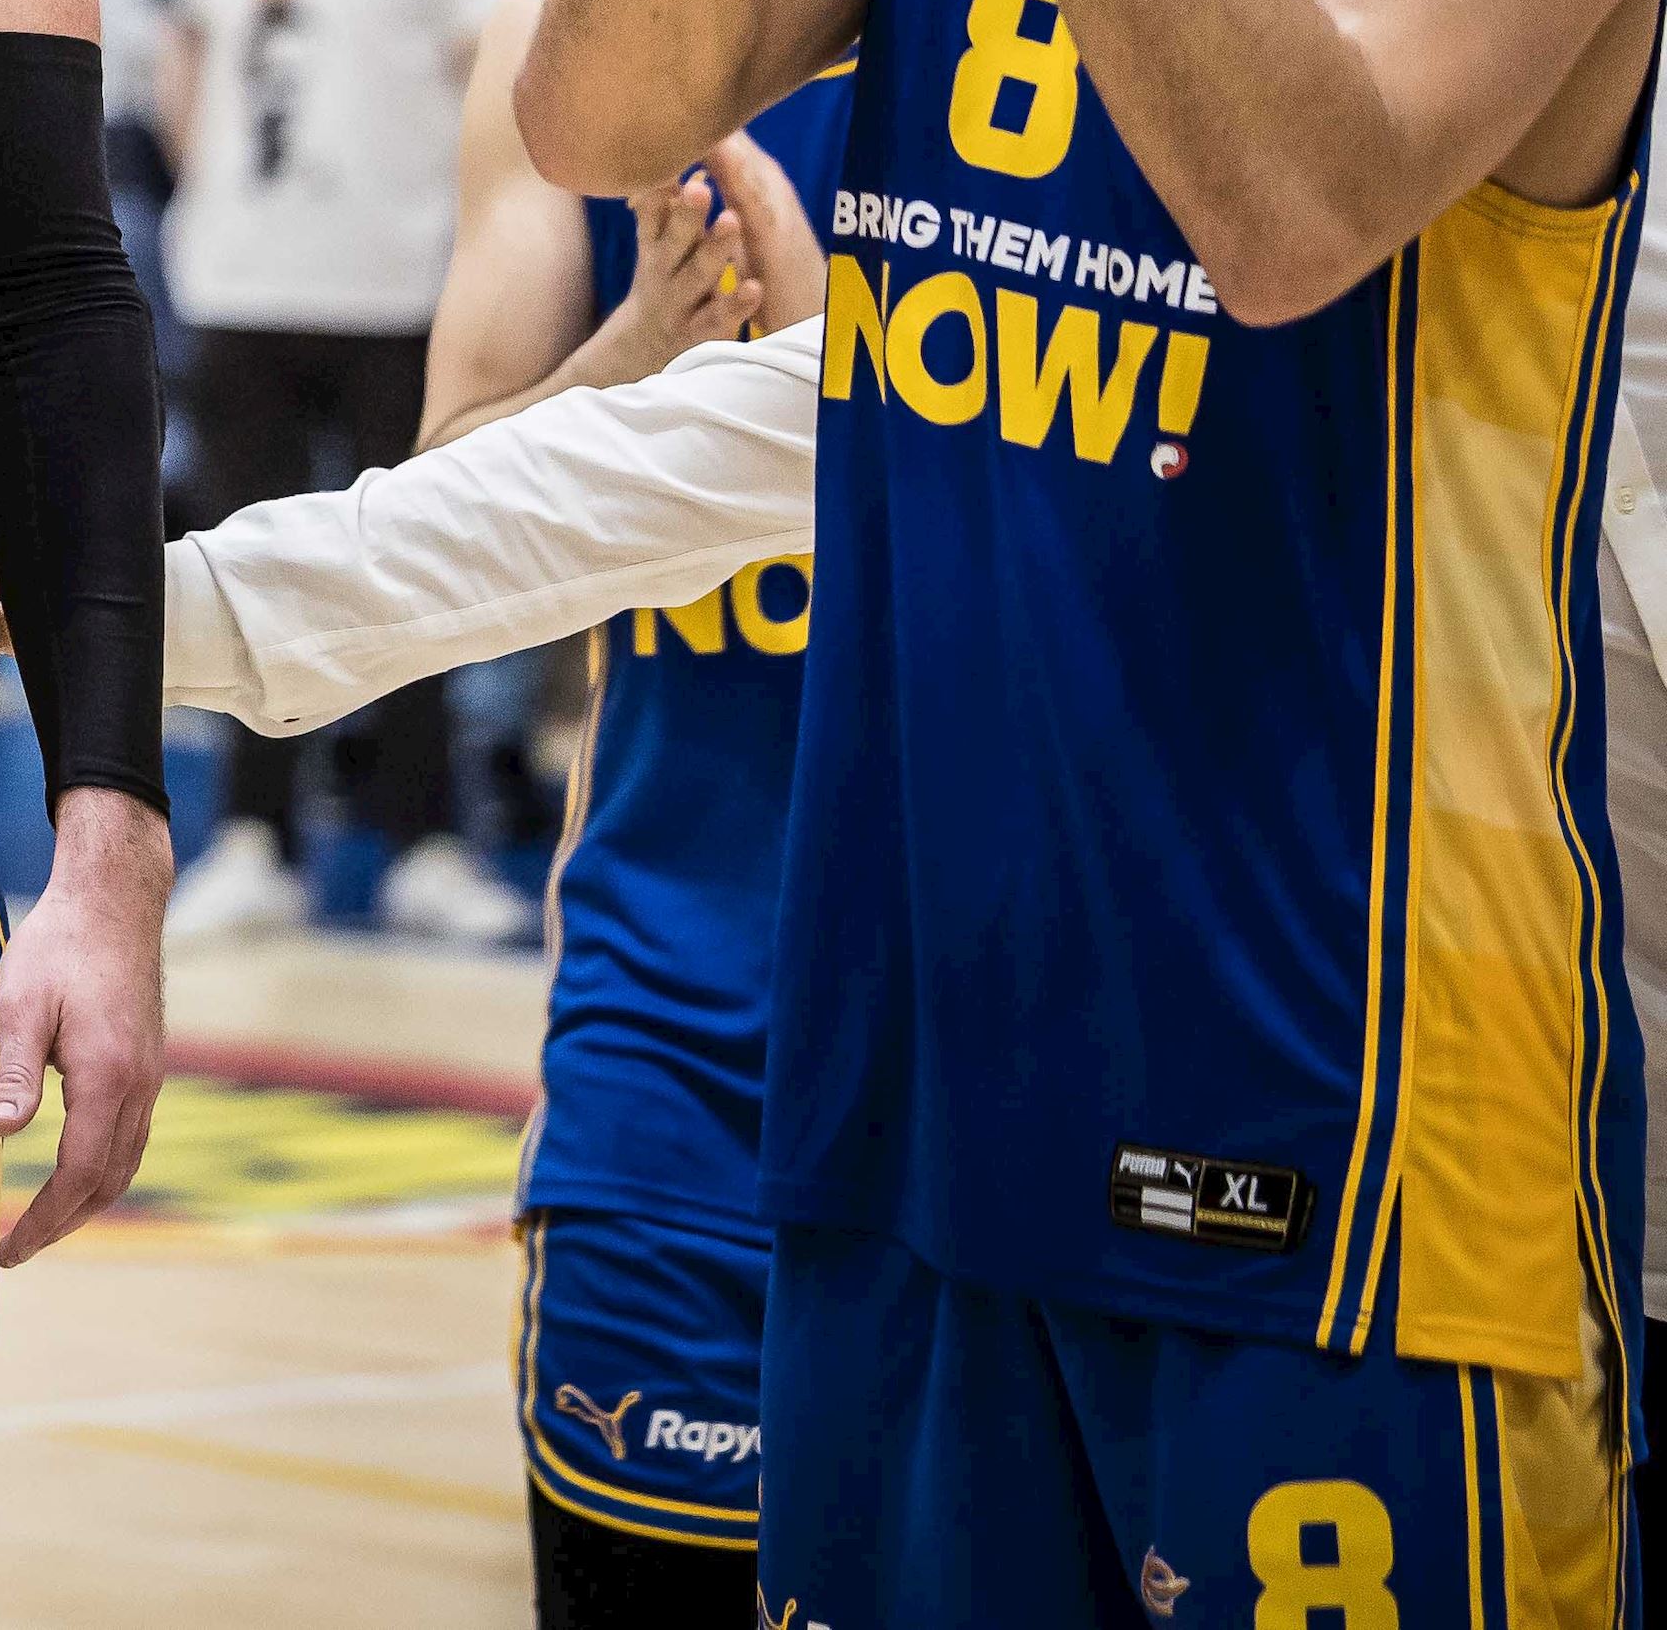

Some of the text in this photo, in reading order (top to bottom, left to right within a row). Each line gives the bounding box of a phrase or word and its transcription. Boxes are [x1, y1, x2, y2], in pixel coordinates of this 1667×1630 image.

[949, 206, 1072, 282] THEM
[1074, 238, 1219, 315] HOME
[821, 253, 1212, 479] NOW!
[1220, 1171, 1268, 1212] XL
[1247, 1479, 1399, 1630] 8
